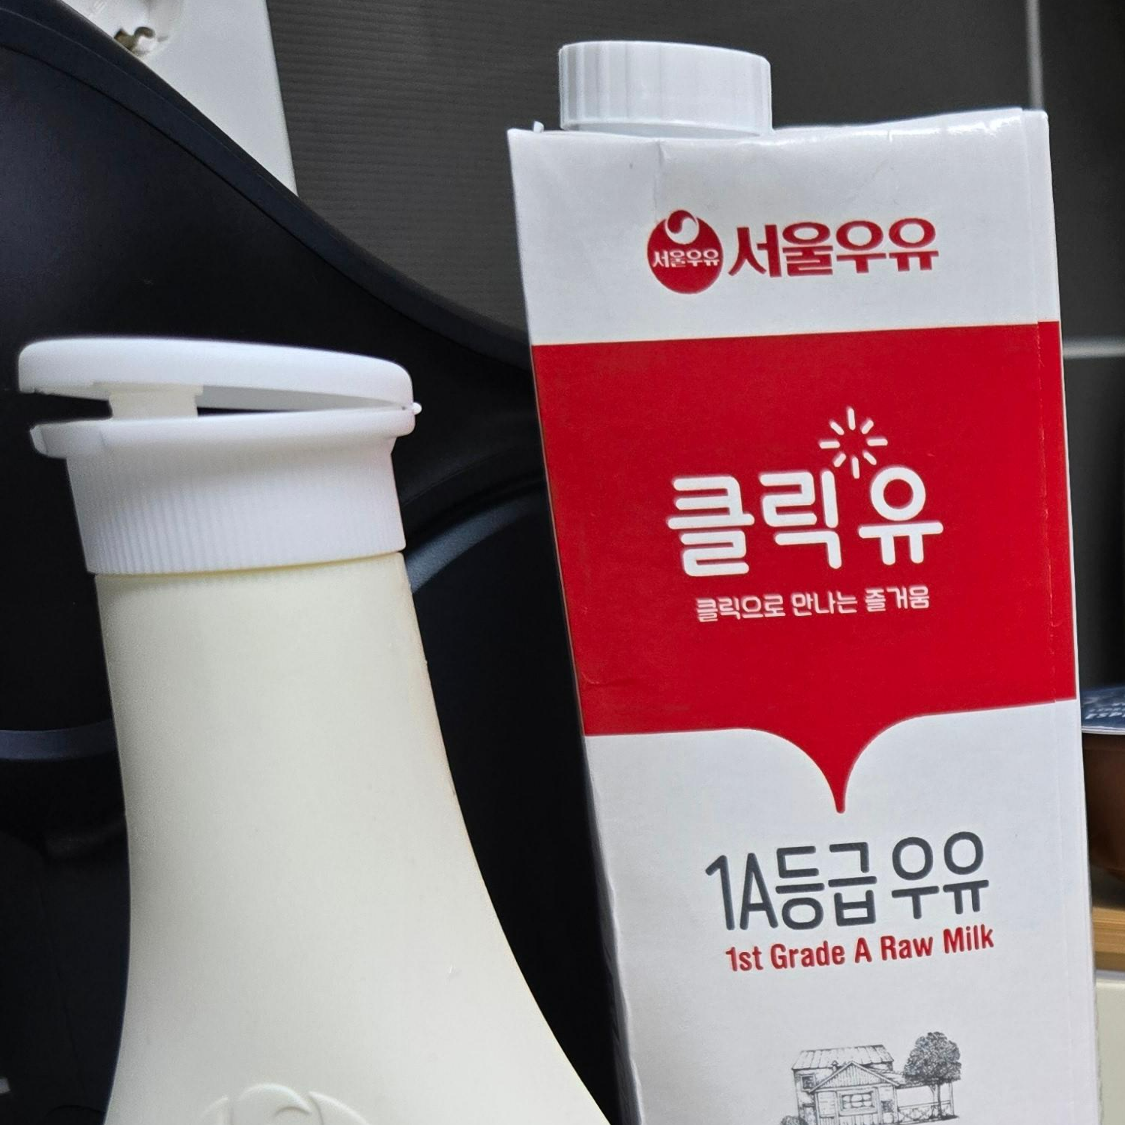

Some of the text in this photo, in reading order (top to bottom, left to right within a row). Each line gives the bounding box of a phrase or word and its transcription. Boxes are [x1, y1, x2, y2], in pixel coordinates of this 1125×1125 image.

[652, 249, 720, 268] 서울우유
[727, 217, 939, 278] 서울우유
[667, 465, 944, 577] 클릭유
[696, 584, 930, 622] 클릭으로 만나는 즐거움
[705, 831, 990, 930] 1A등급 우유
[725, 924, 995, 972] 1st Grade A Raw Milk
